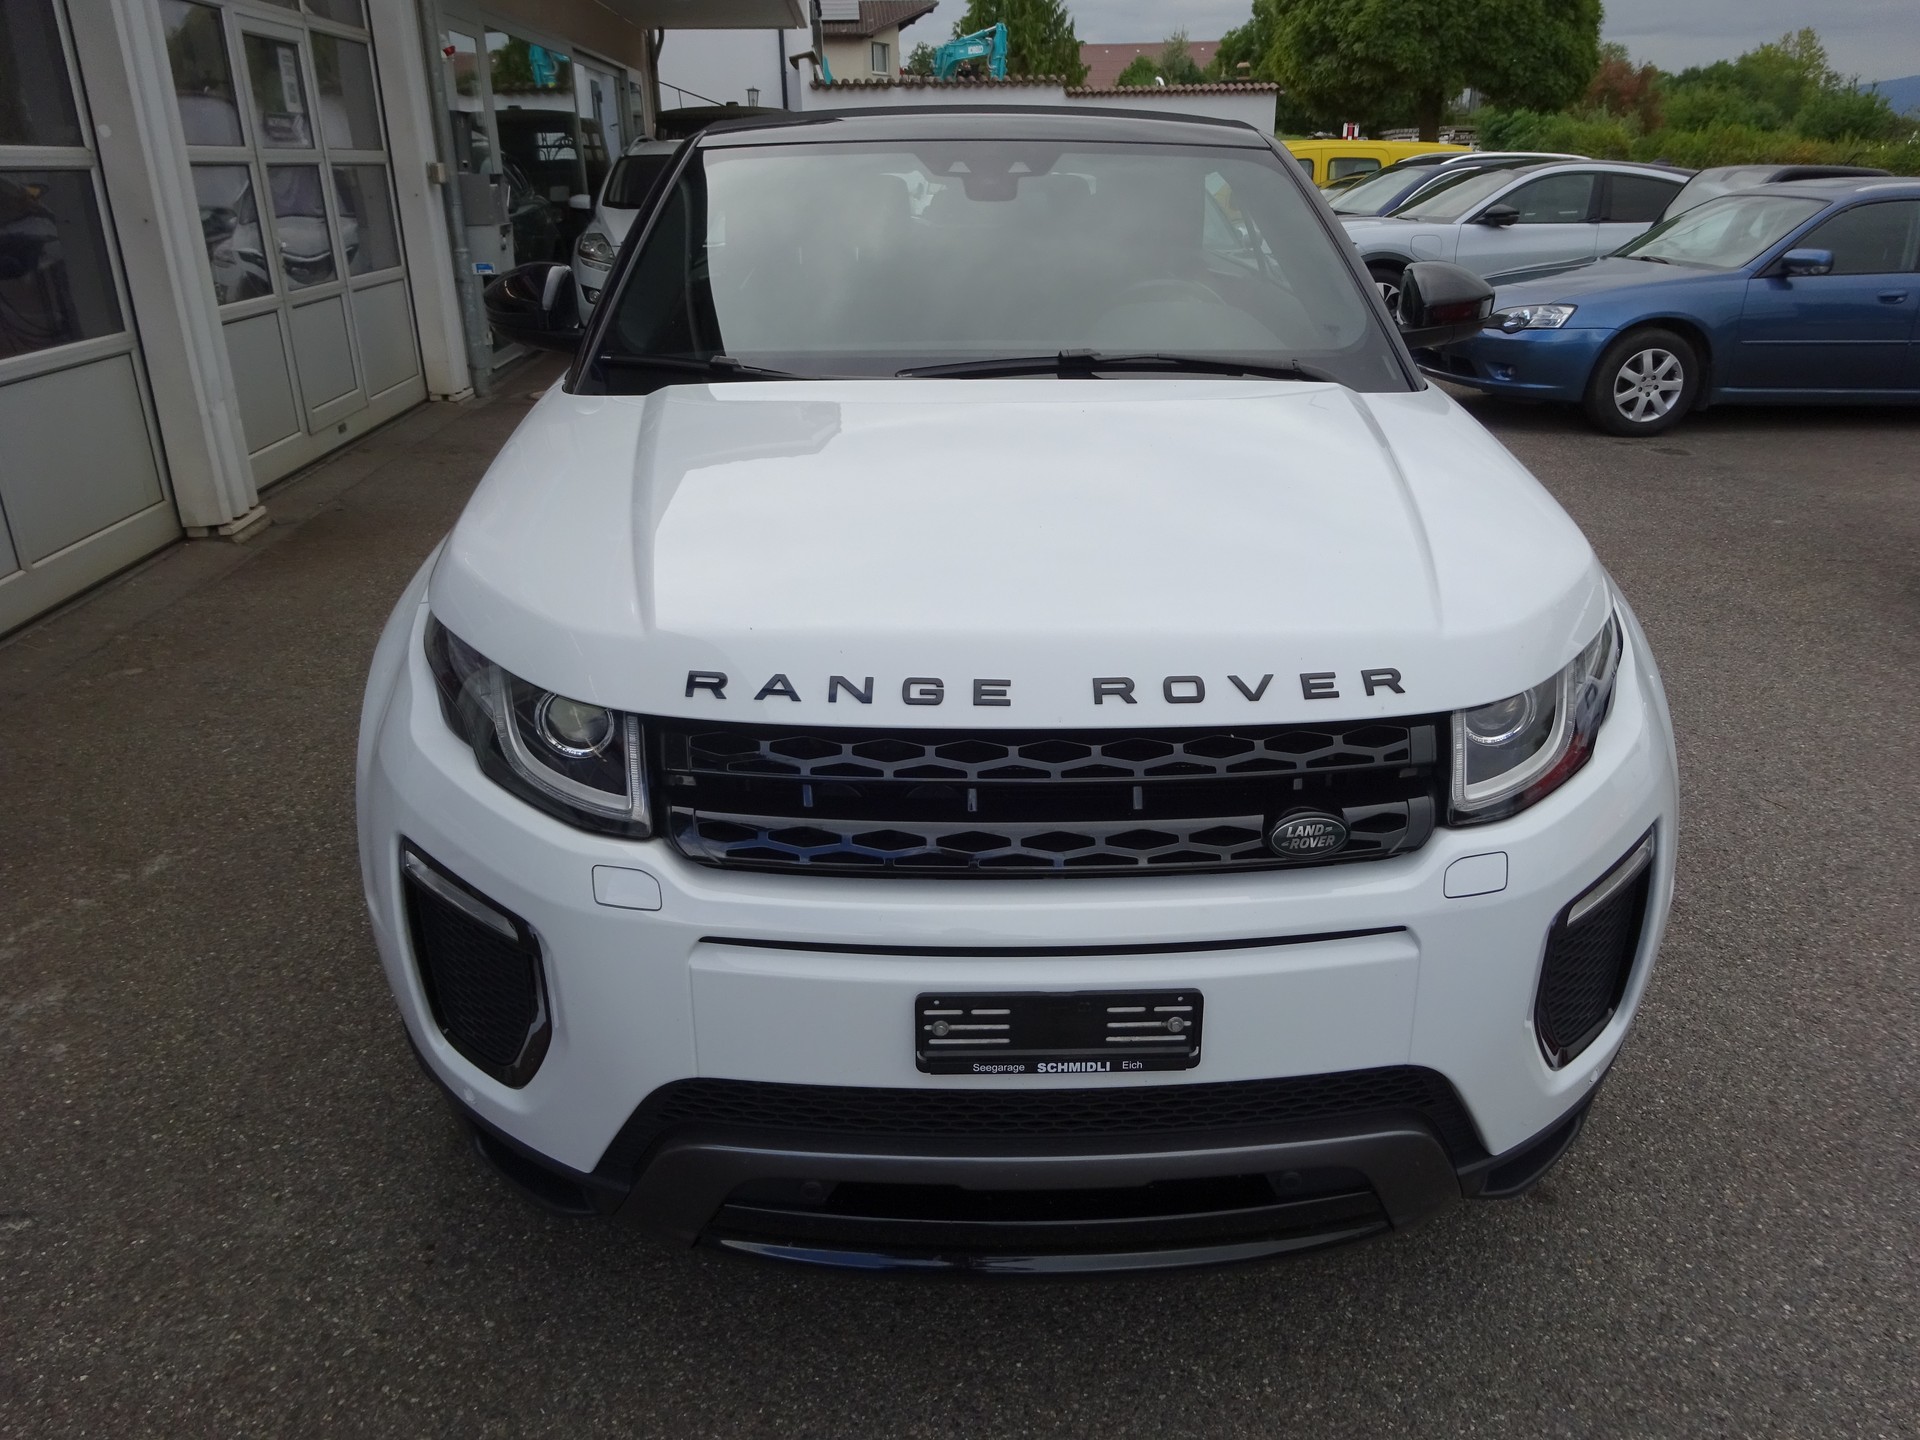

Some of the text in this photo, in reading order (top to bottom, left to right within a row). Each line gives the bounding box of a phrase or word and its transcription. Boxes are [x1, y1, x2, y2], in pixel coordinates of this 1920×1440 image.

[685, 667, 1406, 706] RANGE ROVER
[1286, 824, 1325, 838] LAND
[1289, 835, 1336, 849] ROVER
[972, 1061, 1143, 1073] Seegarage SCHMIDLI Eich
